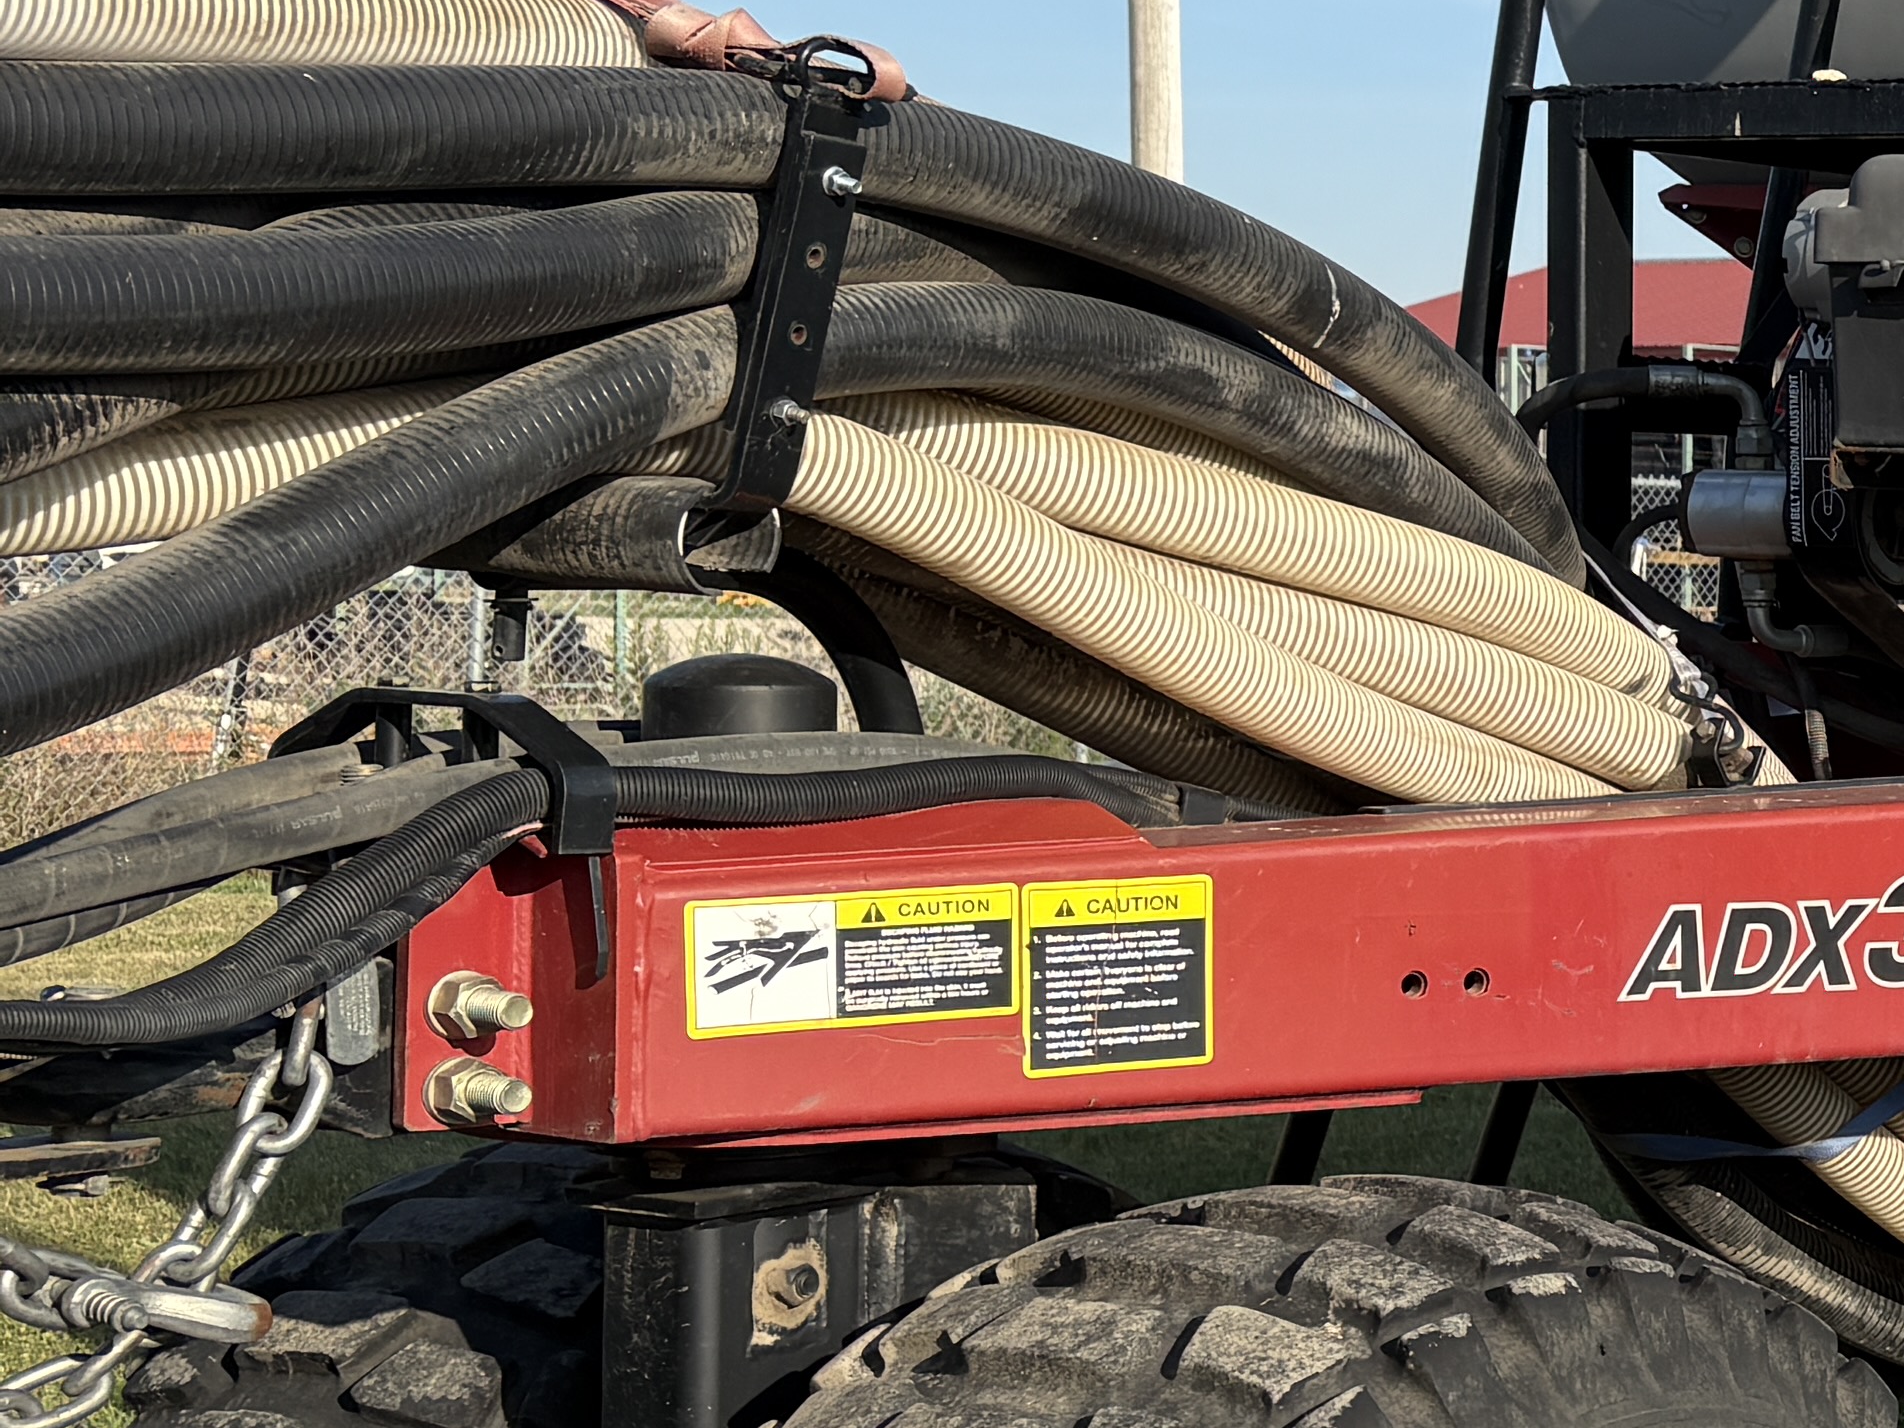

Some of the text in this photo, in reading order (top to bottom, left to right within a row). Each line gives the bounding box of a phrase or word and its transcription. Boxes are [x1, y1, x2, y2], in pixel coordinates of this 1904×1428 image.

[1788, 374, 1802, 543] FAN BELT TENSION ADJUSTMENT
[898, 898, 990, 917] CAUTION
[1086, 894, 1179, 915] CAUTION
